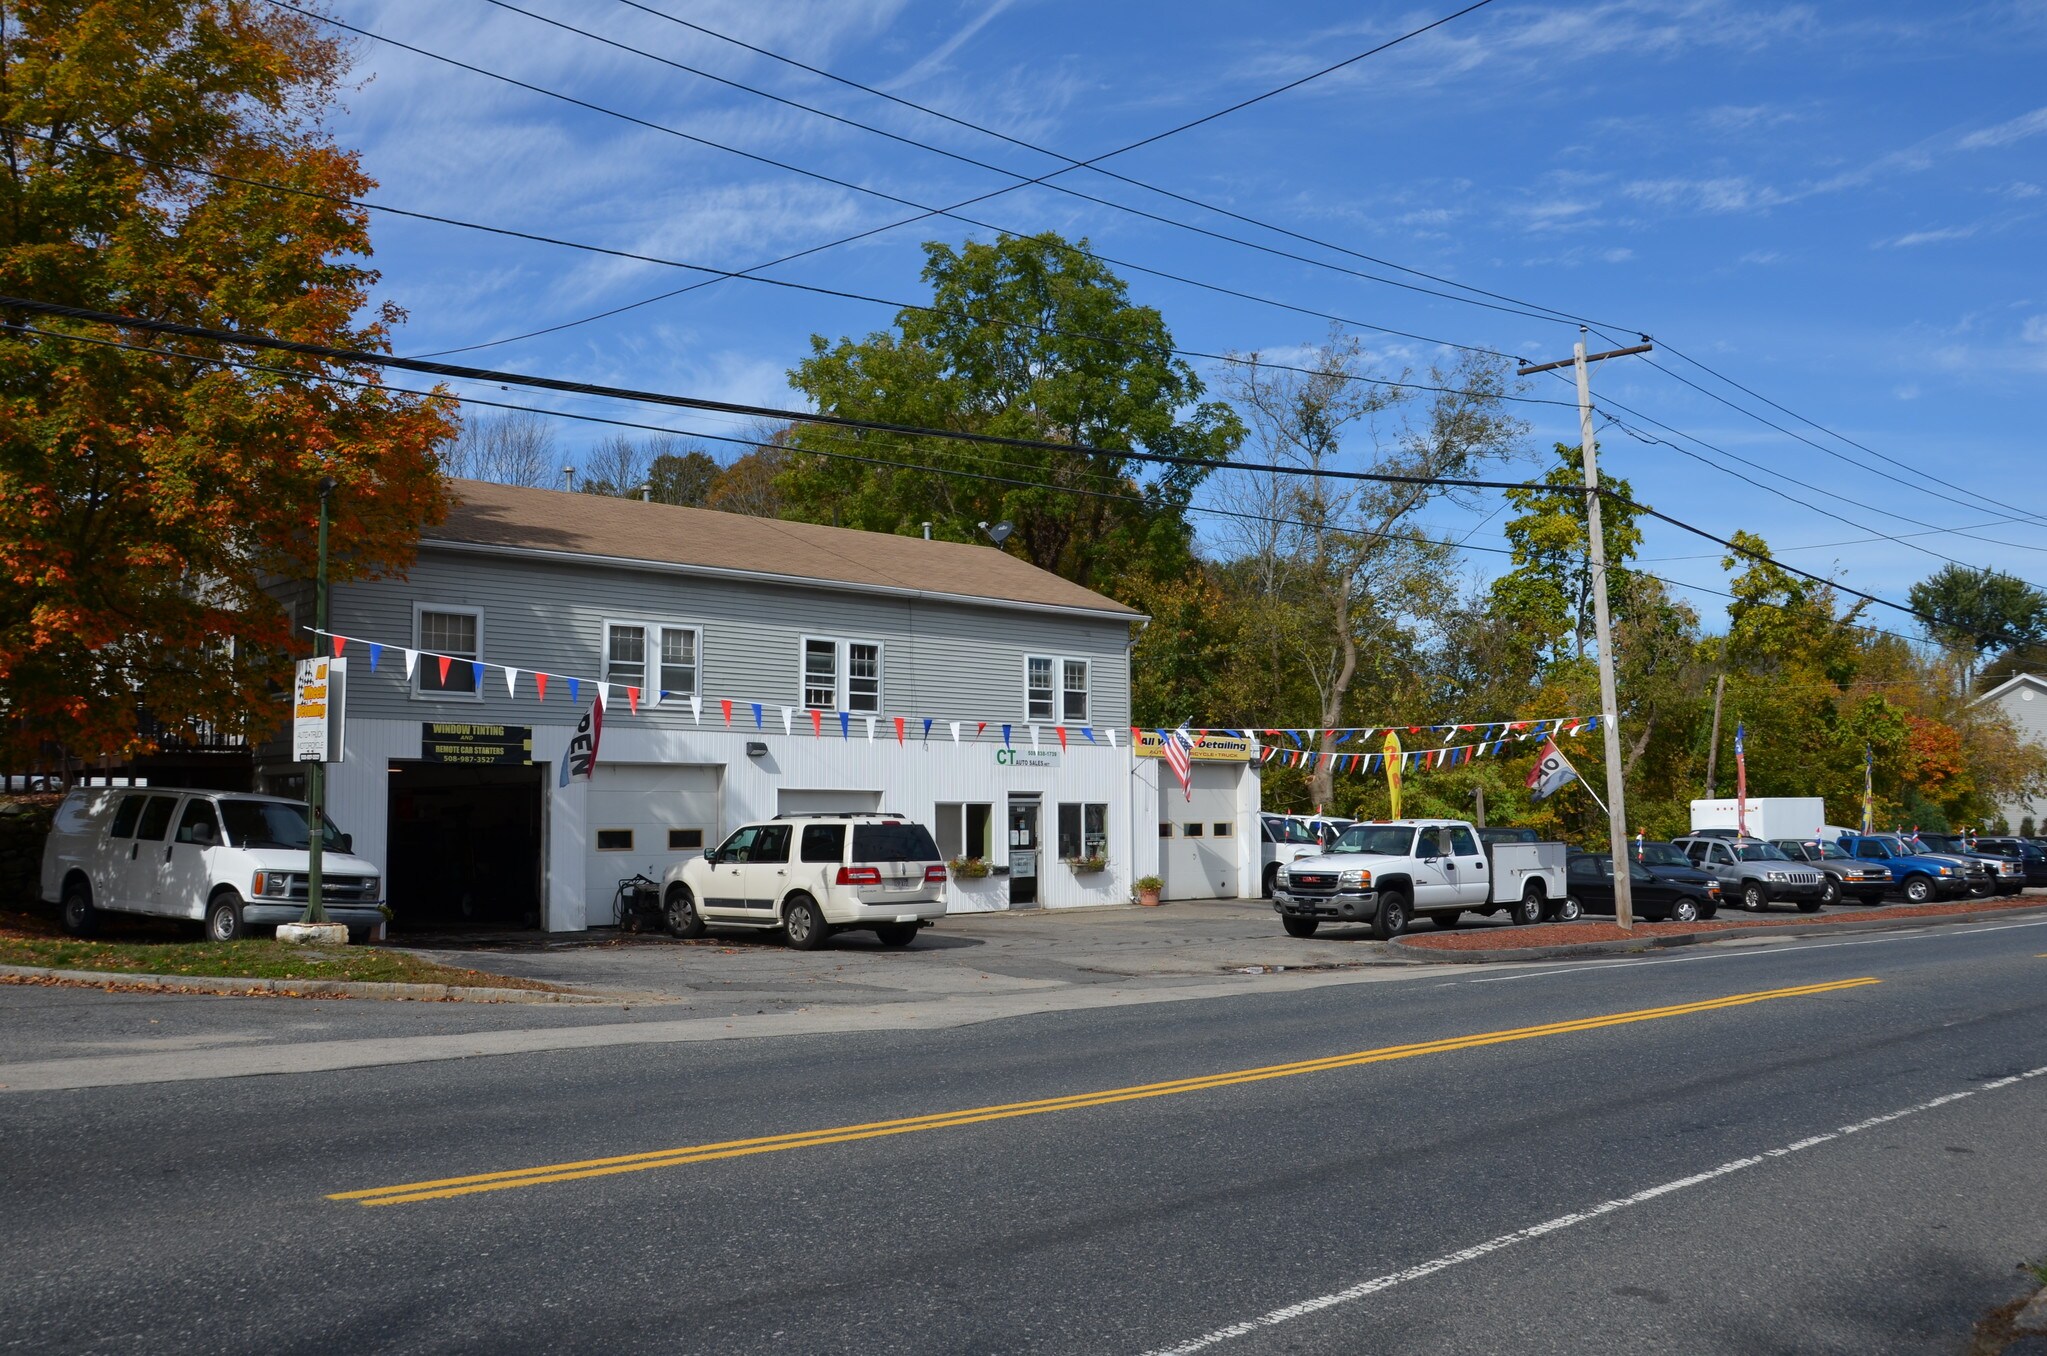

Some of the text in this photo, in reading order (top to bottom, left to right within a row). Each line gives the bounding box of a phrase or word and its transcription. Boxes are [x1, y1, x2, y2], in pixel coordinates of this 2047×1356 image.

[433, 724, 504, 736] WINDOW TINTING
[435, 745, 504, 755] REMOTE CAR STARTERS
[1141, 737, 1155, 748] All
[1198, 740, 1247, 752] Detailing
[443, 755, 495, 763] 508-987-3527
[997, 749, 1016, 765] CT
